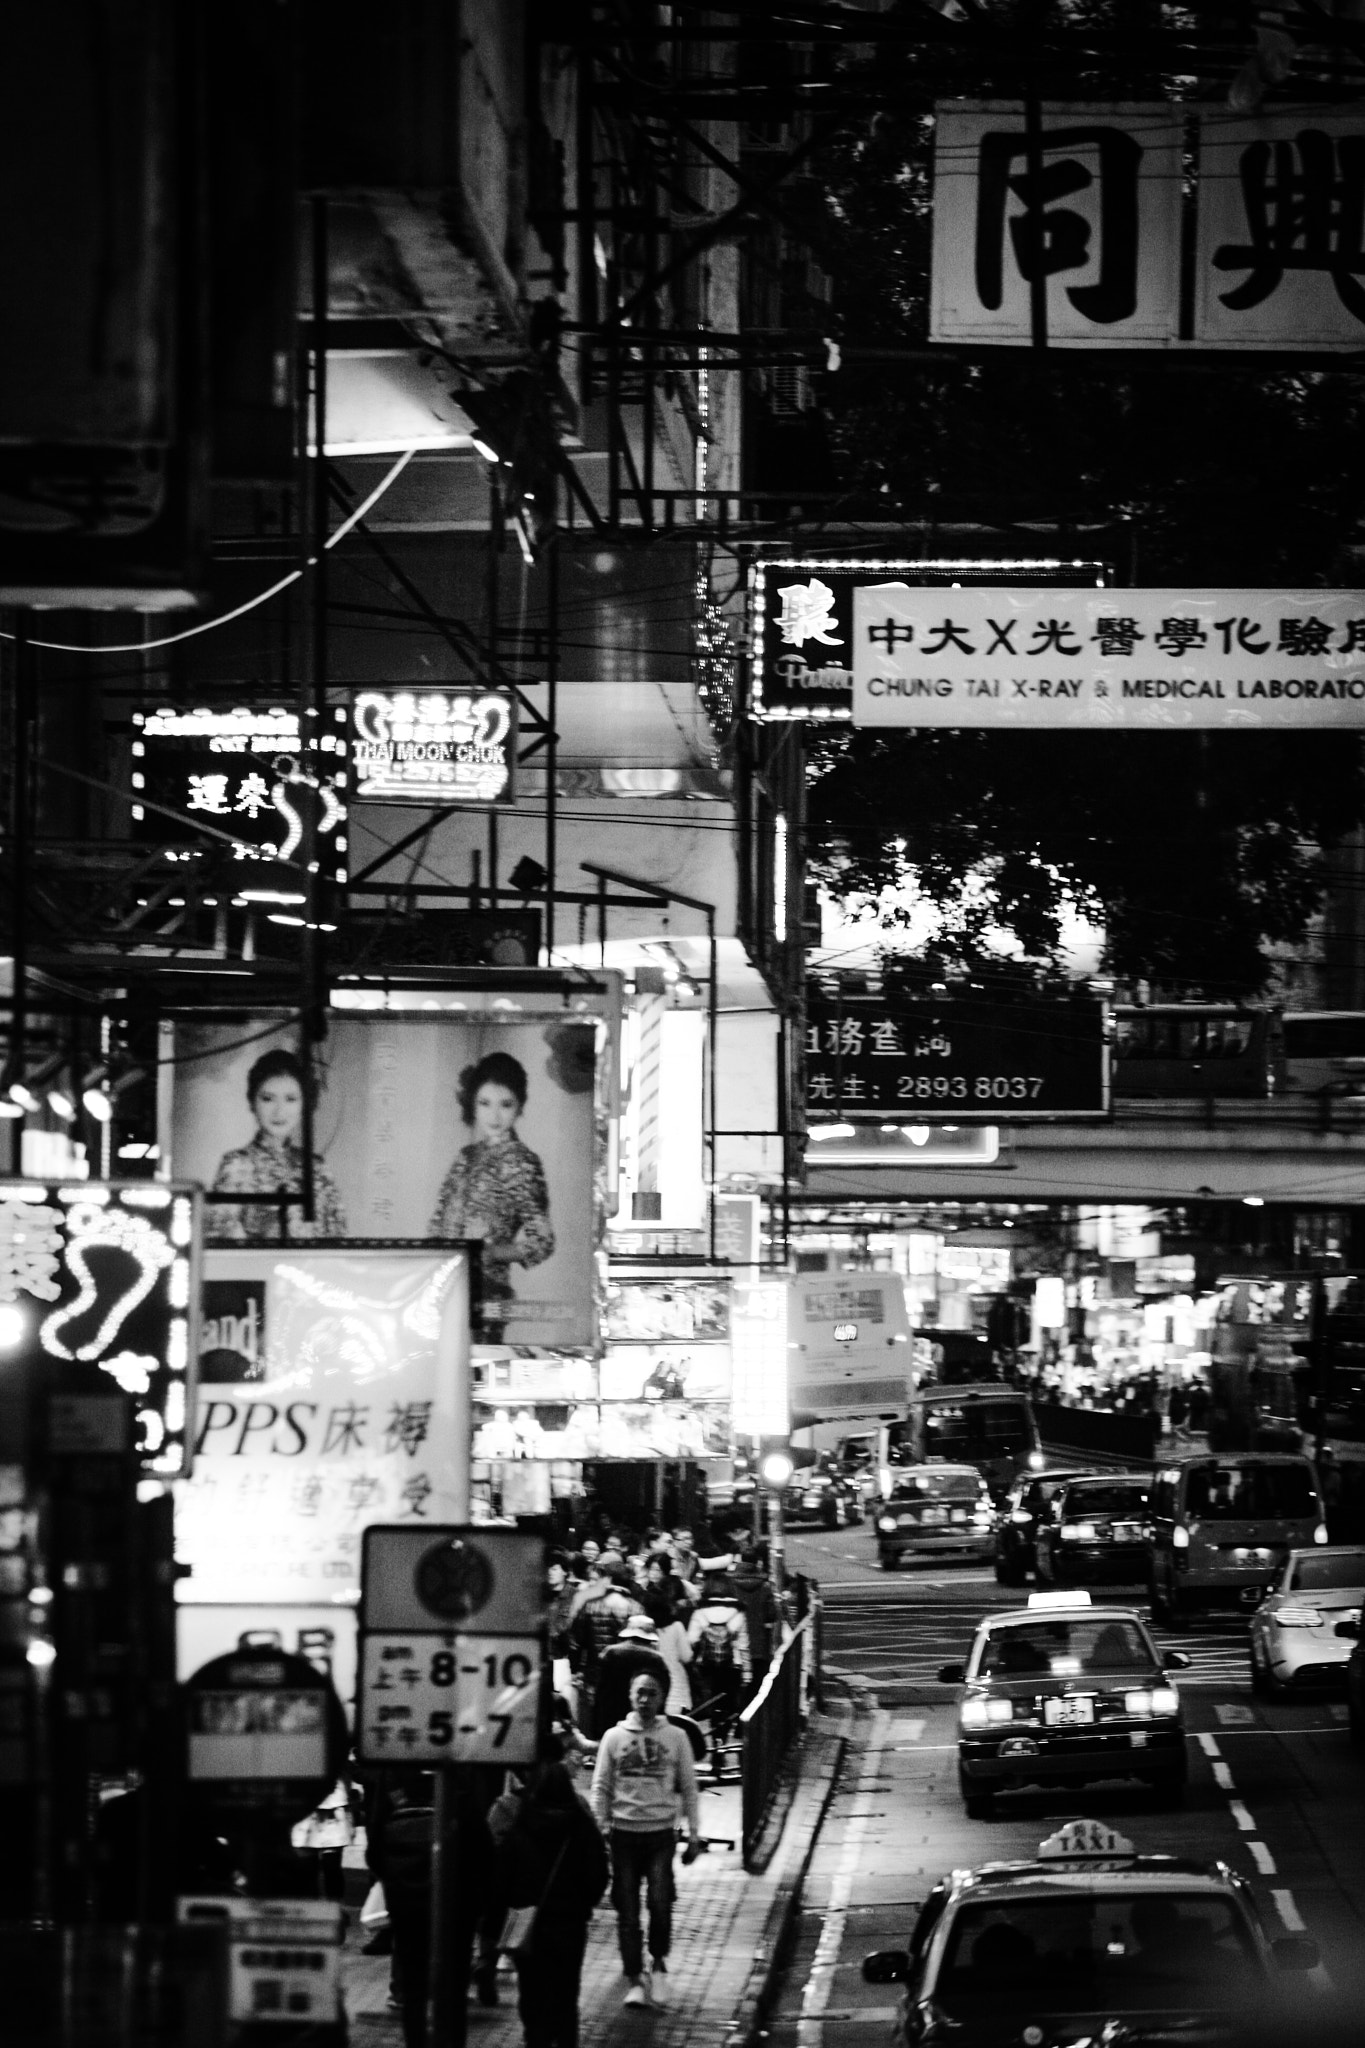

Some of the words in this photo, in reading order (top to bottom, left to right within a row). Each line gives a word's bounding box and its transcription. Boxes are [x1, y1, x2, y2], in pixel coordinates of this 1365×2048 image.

[867, 677, 953, 697] CHUNG
[966, 679, 1000, 698] TAI
[1012, 678, 1083, 698] X-RAY
[1122, 679, 1226, 699] MEDICAL
[1237, 679, 1365, 699] LABORATO
[352, 740, 394, 761] THAI
[897, 1076, 968, 1098] 2893
[974, 1076, 1044, 1098] 8037
[1058, 1835, 1116, 1851] TAXI
